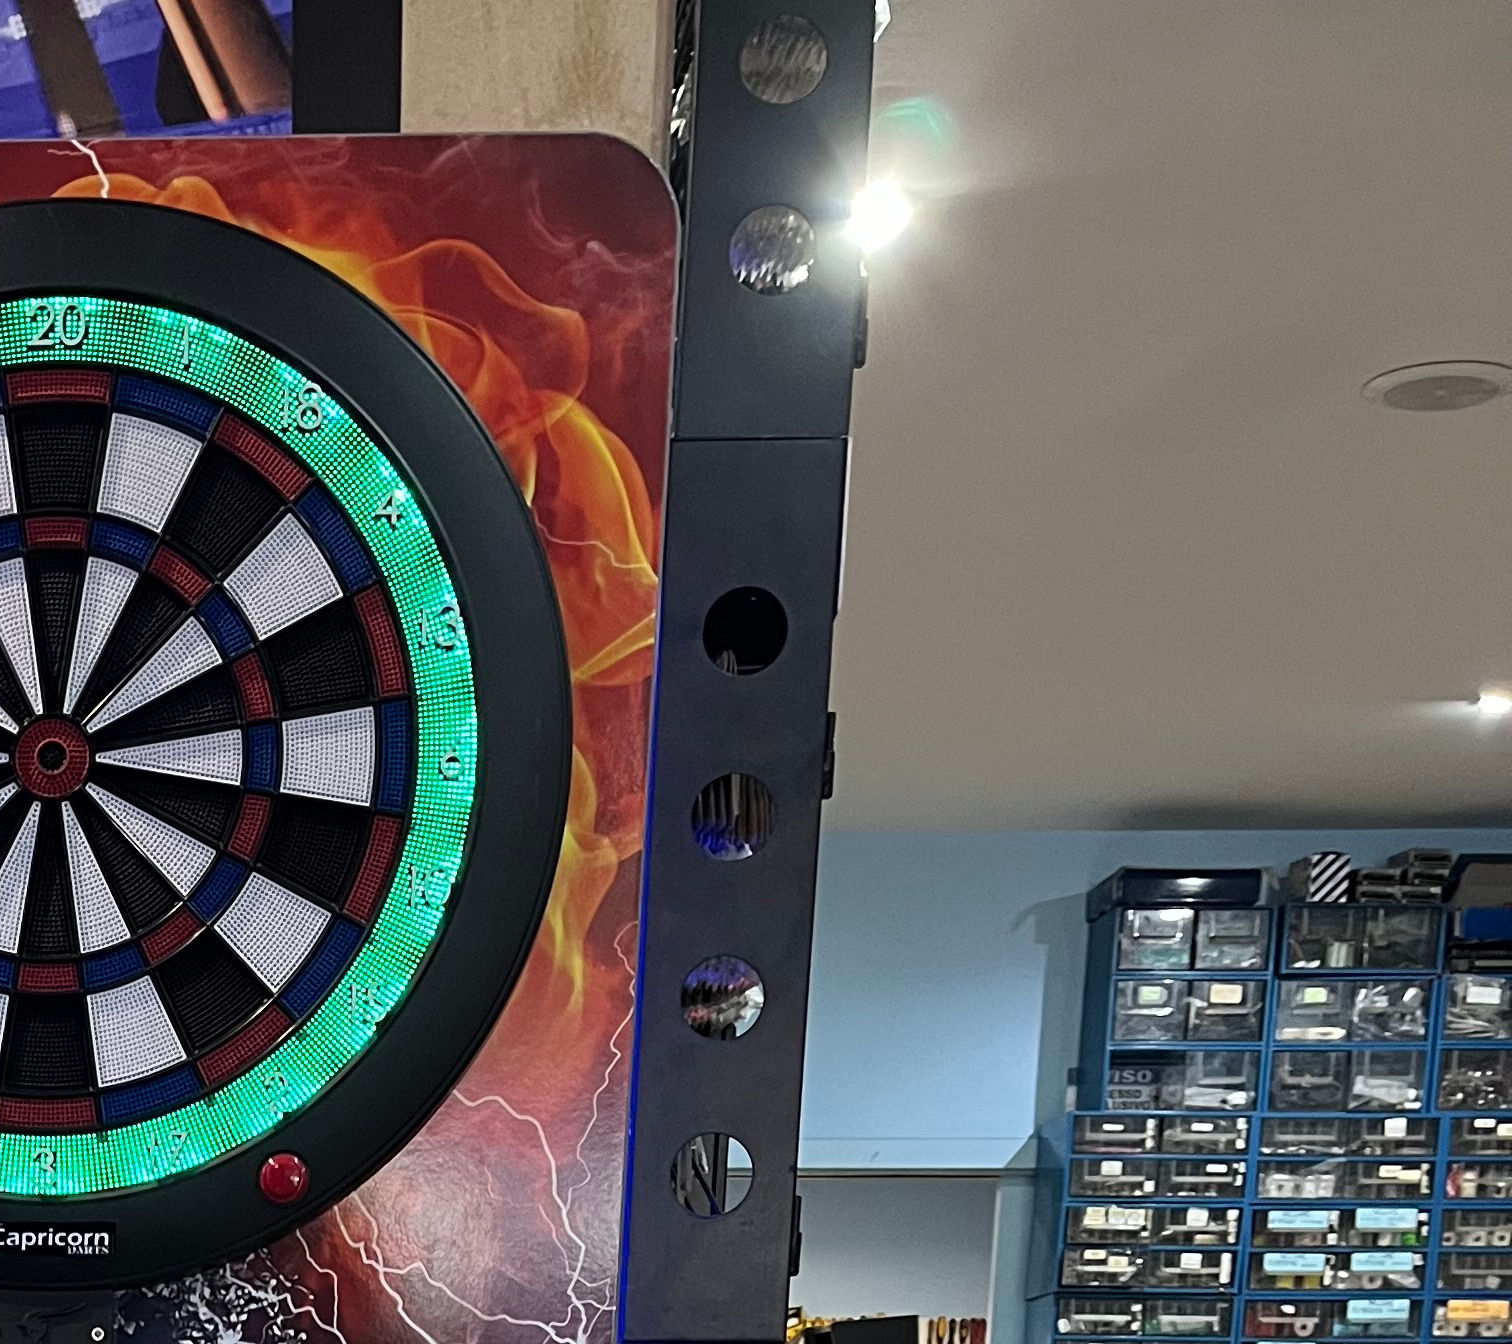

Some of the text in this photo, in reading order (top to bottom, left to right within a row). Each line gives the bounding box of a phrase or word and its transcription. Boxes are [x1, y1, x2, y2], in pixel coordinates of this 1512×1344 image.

[28, 303, 86, 346] 20
[180, 323, 191, 366] 1
[281, 382, 325, 430] 18
[375, 490, 402, 525] 4
[419, 602, 461, 647] 13
[409, 865, 452, 908] 10
[67, 1246, 109, 1255] DARTS
